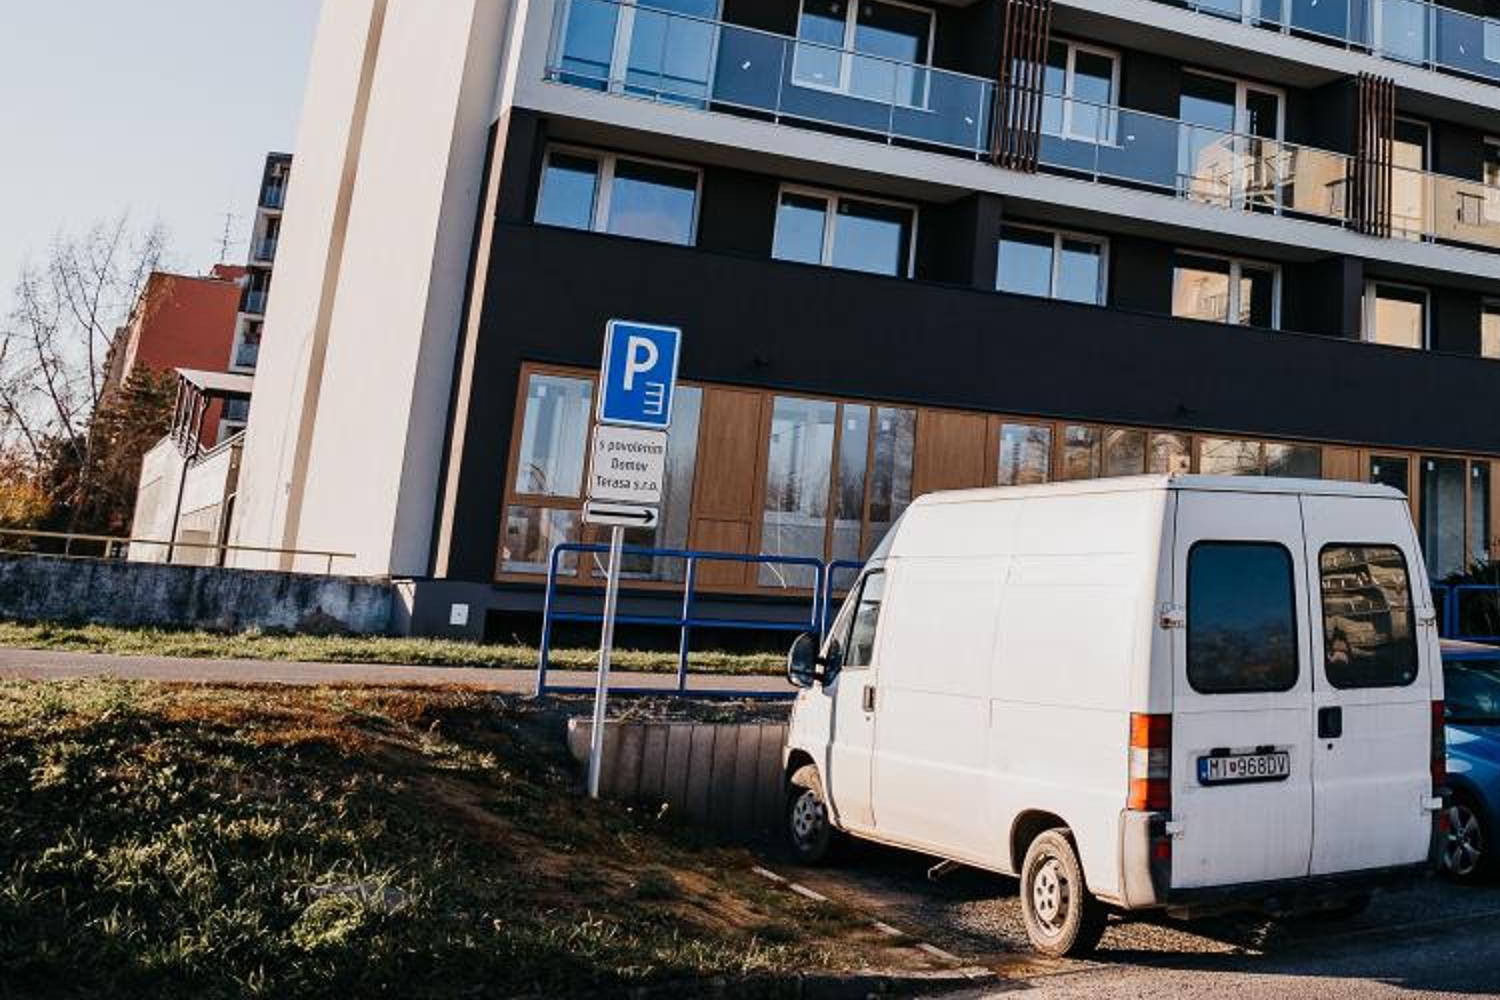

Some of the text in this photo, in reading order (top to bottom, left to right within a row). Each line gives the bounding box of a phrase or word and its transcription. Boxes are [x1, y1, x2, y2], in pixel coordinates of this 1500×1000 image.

[623, 335, 659, 391] P
[611, 457, 649, 471] Domov
[597, 475, 631, 489] Terasa
